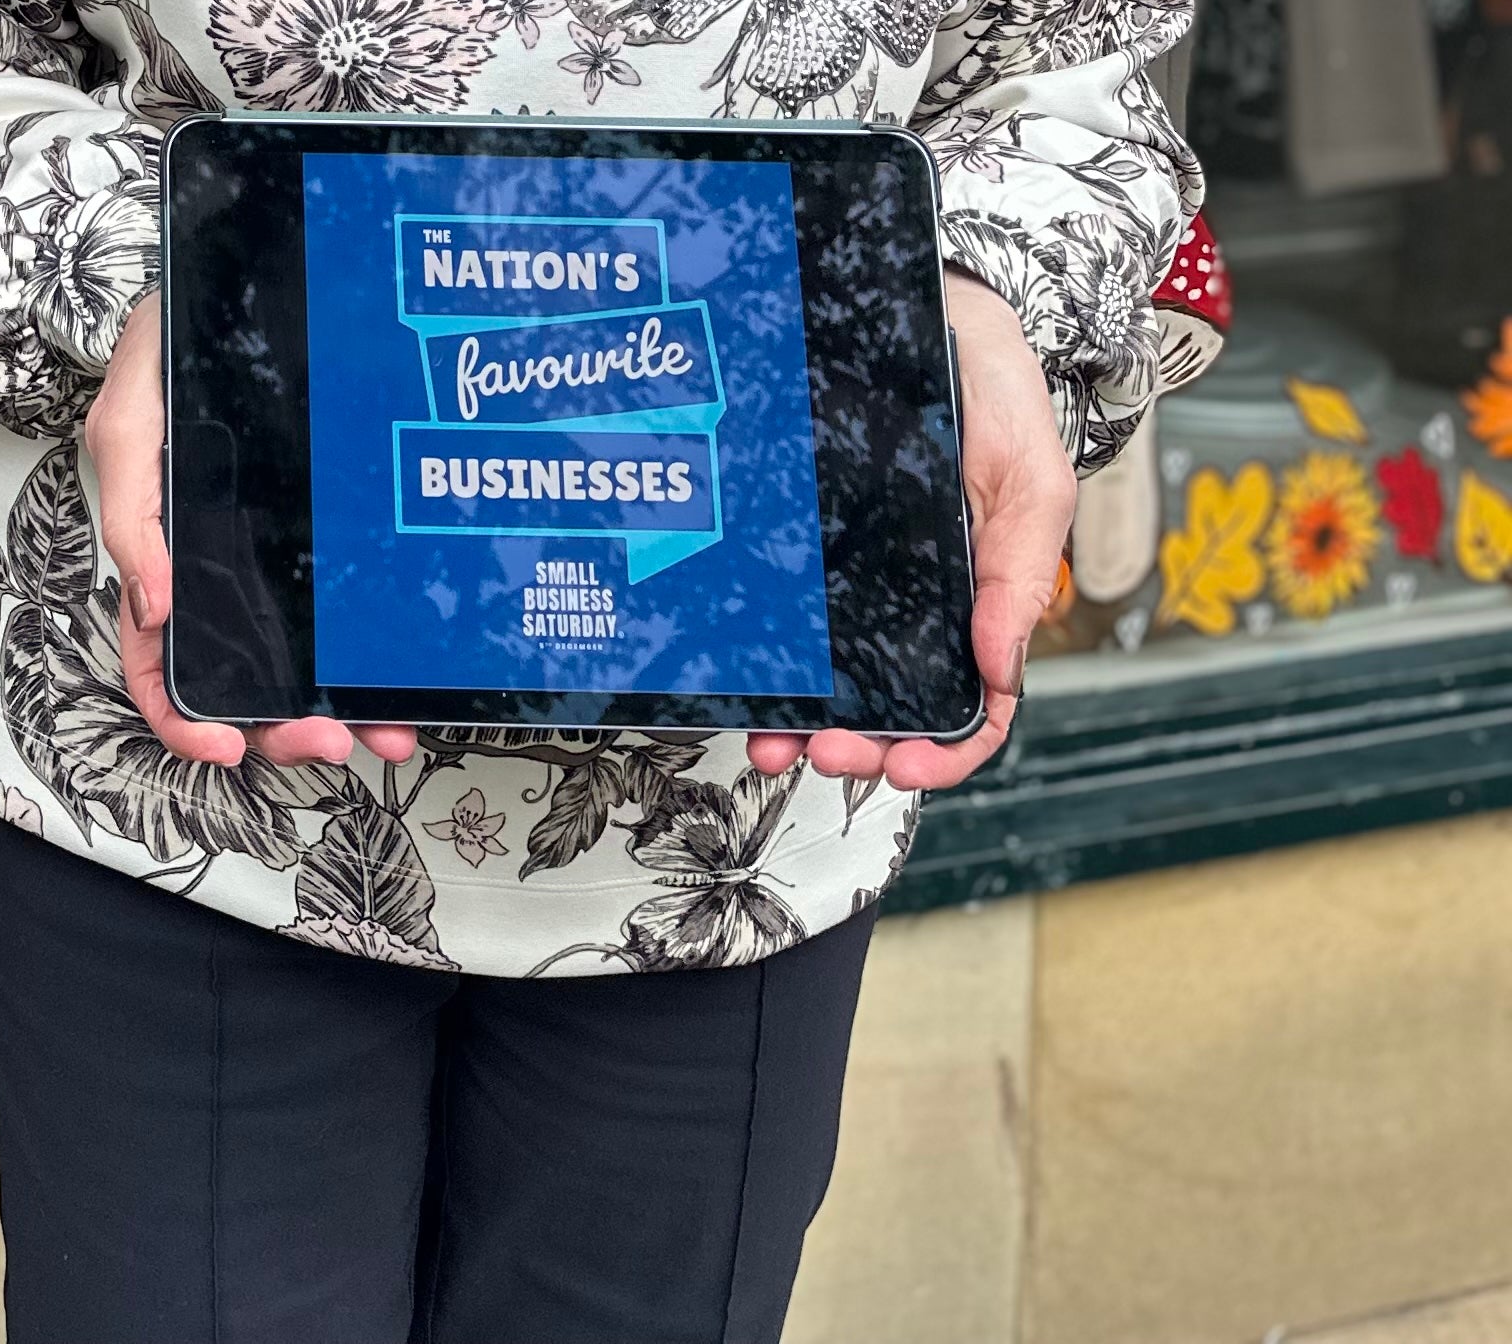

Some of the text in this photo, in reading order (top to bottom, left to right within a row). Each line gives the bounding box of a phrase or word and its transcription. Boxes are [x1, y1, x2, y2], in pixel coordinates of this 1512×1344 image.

[423, 229, 452, 244] THE
[423, 249, 640, 292] NATION'S
[457, 317, 693, 421] favourite
[420, 457, 693, 502] BUSINESSES
[535, 561, 599, 586] SMALL
[523, 587, 614, 612] BUSINESS
